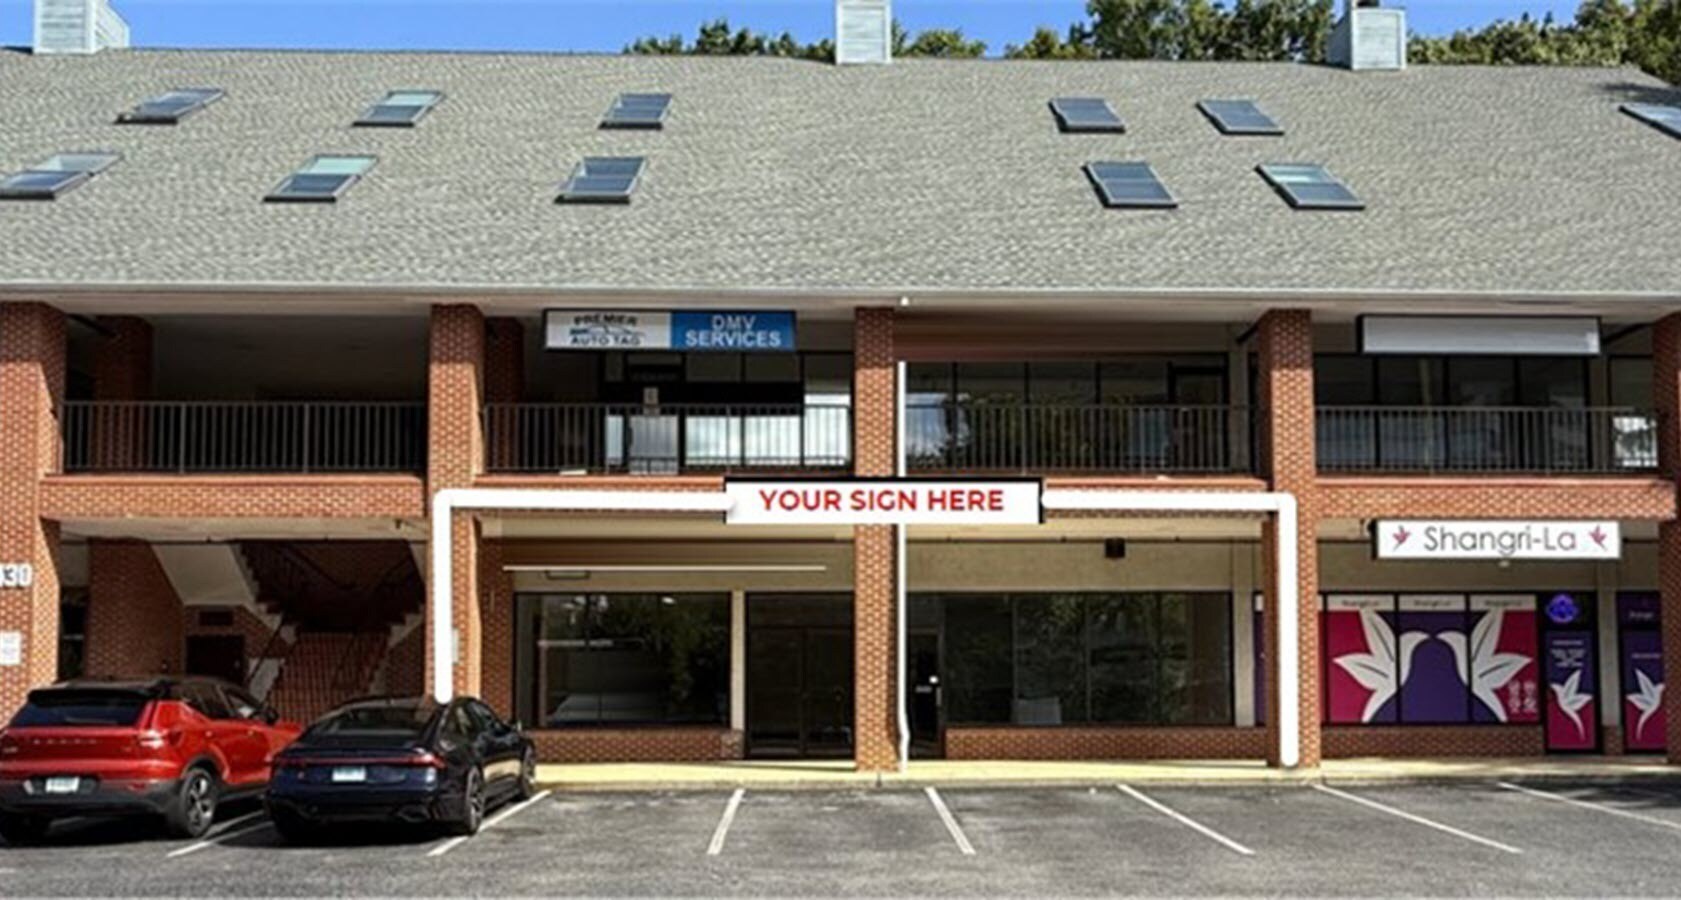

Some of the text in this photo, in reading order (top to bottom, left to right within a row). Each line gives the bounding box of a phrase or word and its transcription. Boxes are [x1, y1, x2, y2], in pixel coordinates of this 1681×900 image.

[574, 314, 638, 326] PREMIER
[712, 315, 756, 330] DMV
[571, 335, 641, 346] AUTO TAG
[685, 331, 781, 347] SERVICES
[1424, 525, 1577, 556] Shangri-La
